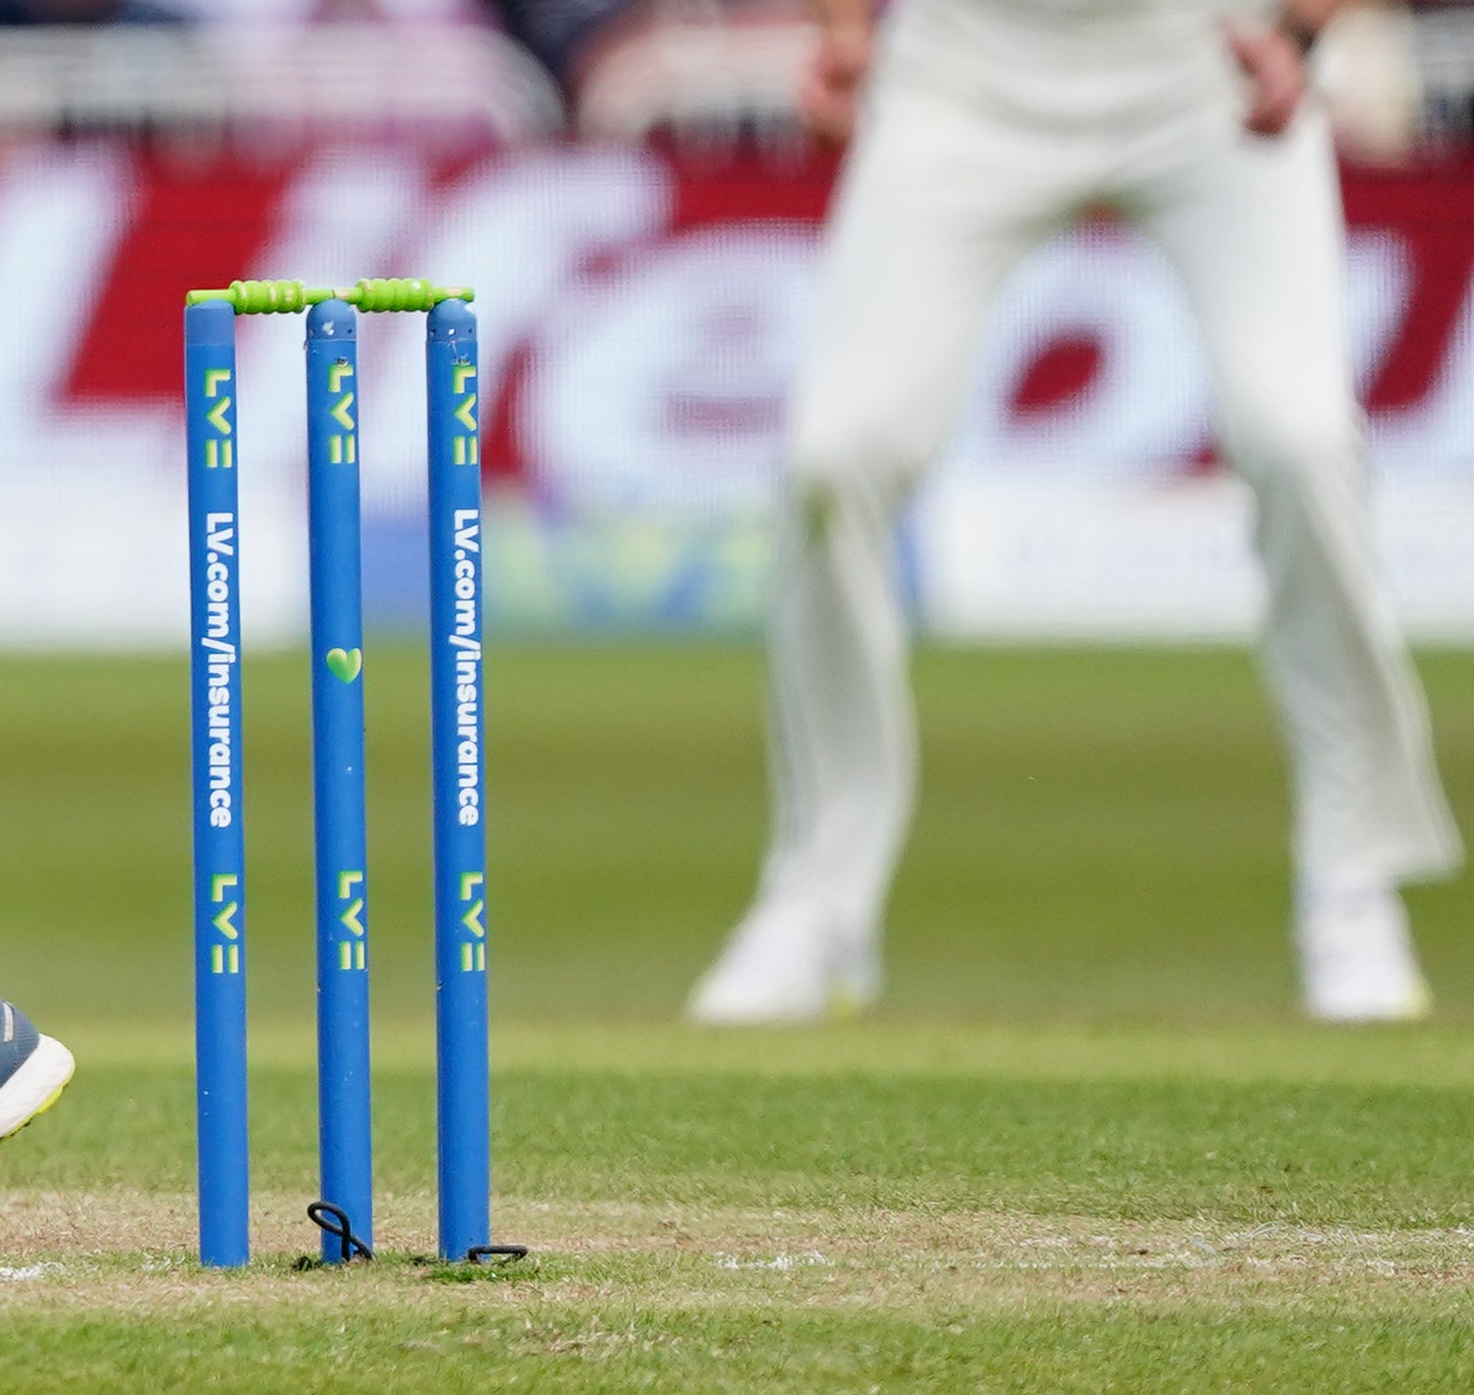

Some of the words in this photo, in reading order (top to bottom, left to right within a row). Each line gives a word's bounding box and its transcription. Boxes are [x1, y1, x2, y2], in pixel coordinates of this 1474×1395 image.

[204, 368, 233, 468] LV=
[202, 512, 236, 828] LV.com/insurance
[448, 509, 482, 826] LV.com/insurance
[211, 873, 239, 974] LV=
